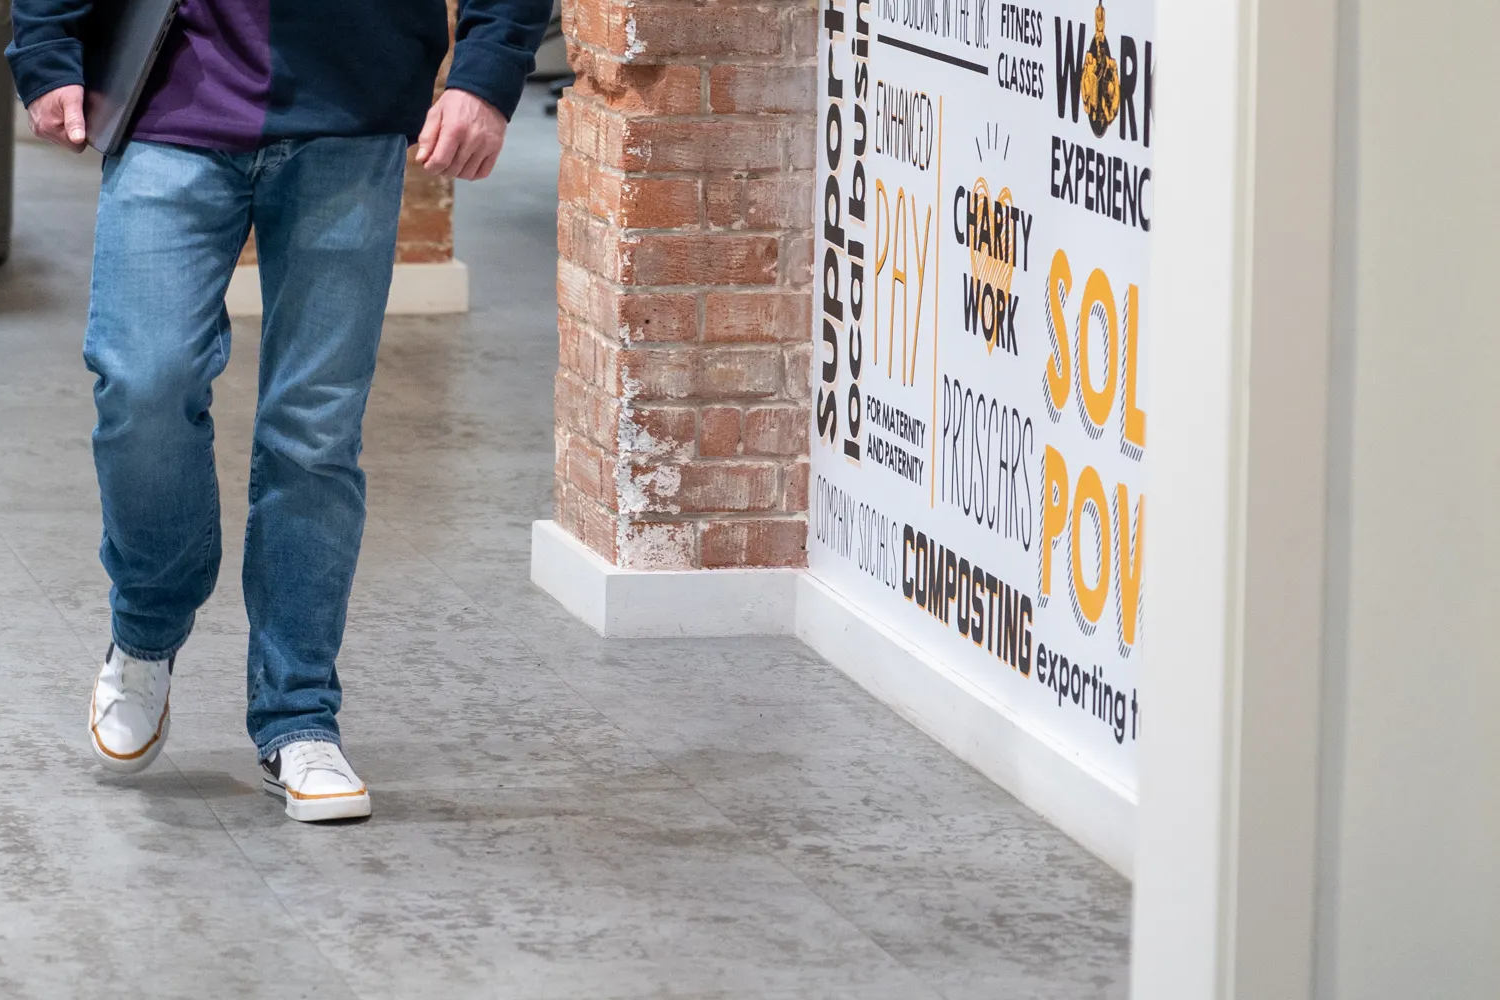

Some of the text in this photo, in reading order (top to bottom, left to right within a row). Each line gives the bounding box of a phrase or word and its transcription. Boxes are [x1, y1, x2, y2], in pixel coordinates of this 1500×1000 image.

[1001, 3, 1043, 48] FITNESS
[998, 52, 1044, 100] CLASSES
[875, 80, 933, 171] ENHANCED
[954, 185, 1033, 272] CHARITY
[1051, 135, 1152, 232] EXPERIENC
[874, 178, 931, 387] PAY
[963, 272, 1019, 357] WORK
[844, 239, 864, 461] local
[1043, 248, 1147, 460] SOL
[867, 395, 926, 449] FOR MATERNITY
[867, 432, 924, 486] AND PATERNITY
[942, 373, 1033, 552] PROSCARS
[816, 474, 898, 590] COMPANY SOCIALS
[902, 523, 1033, 679] COMPOSTING
[1037, 642, 1142, 745] exporting t
